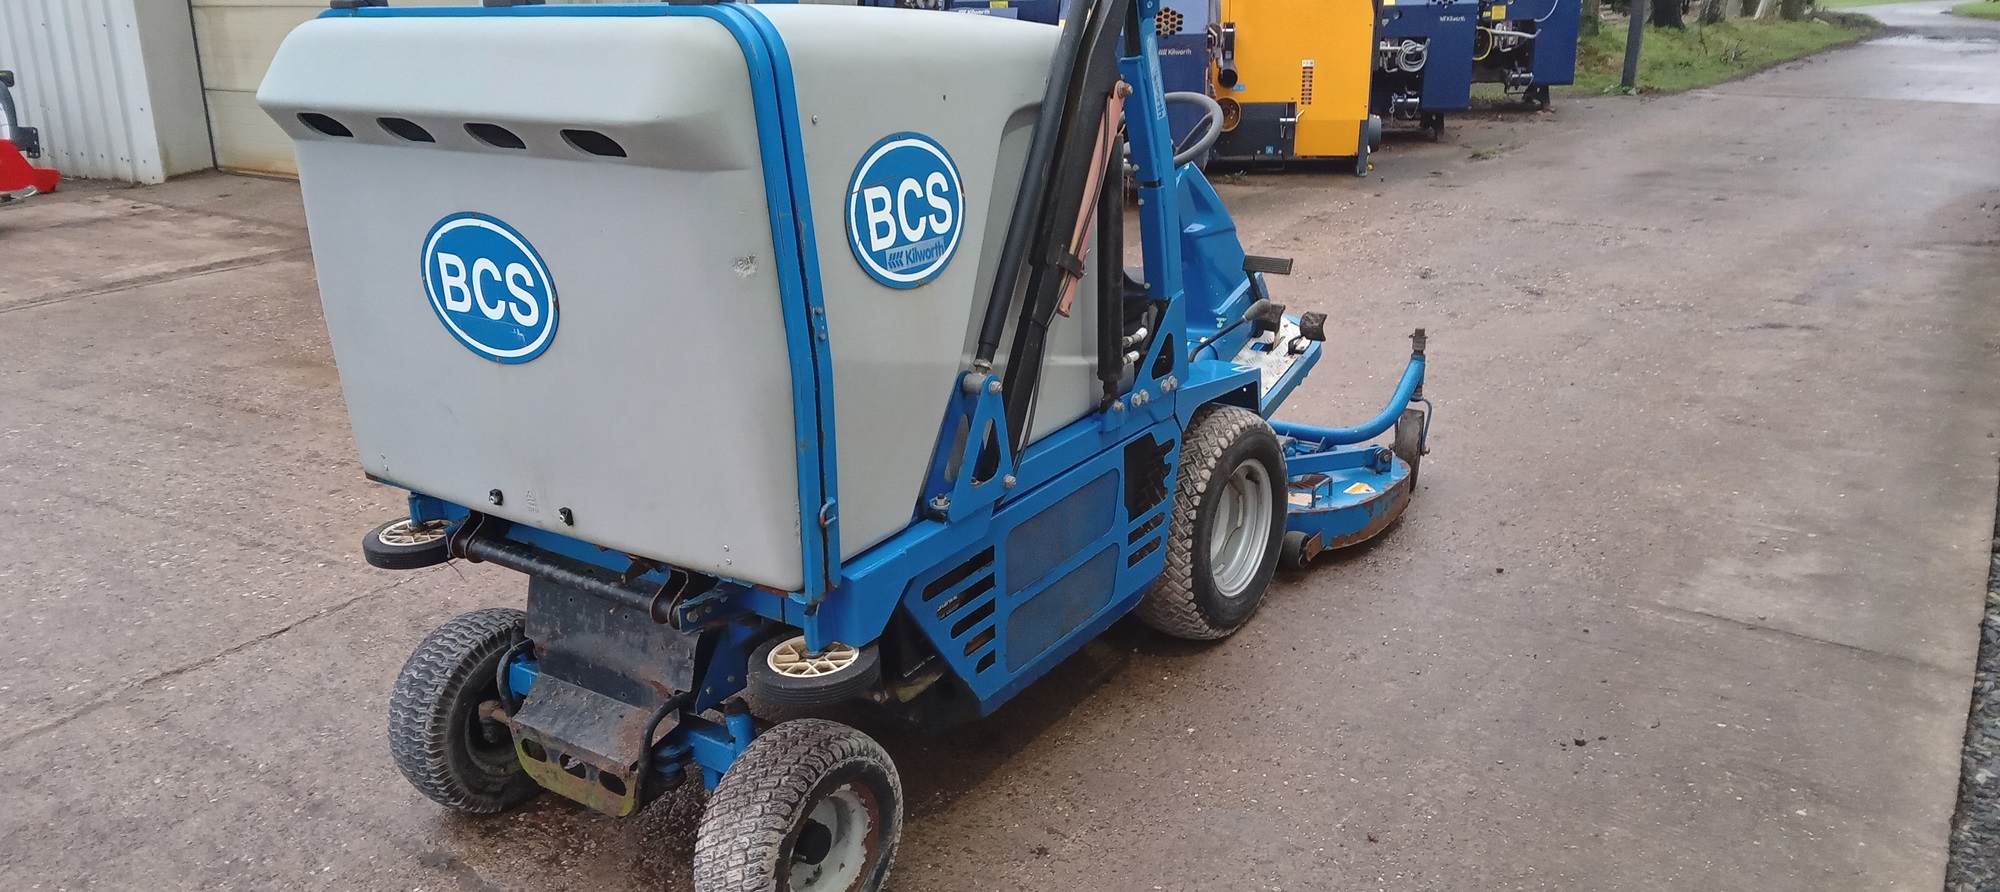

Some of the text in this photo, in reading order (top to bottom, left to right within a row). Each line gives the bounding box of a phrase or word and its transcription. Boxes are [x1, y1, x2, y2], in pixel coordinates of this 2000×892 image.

[1168, 48, 1191, 56] Kilworth
[863, 171, 953, 252] BCS
[905, 241, 945, 266] Kilworth
[437, 252, 540, 327] BCS
